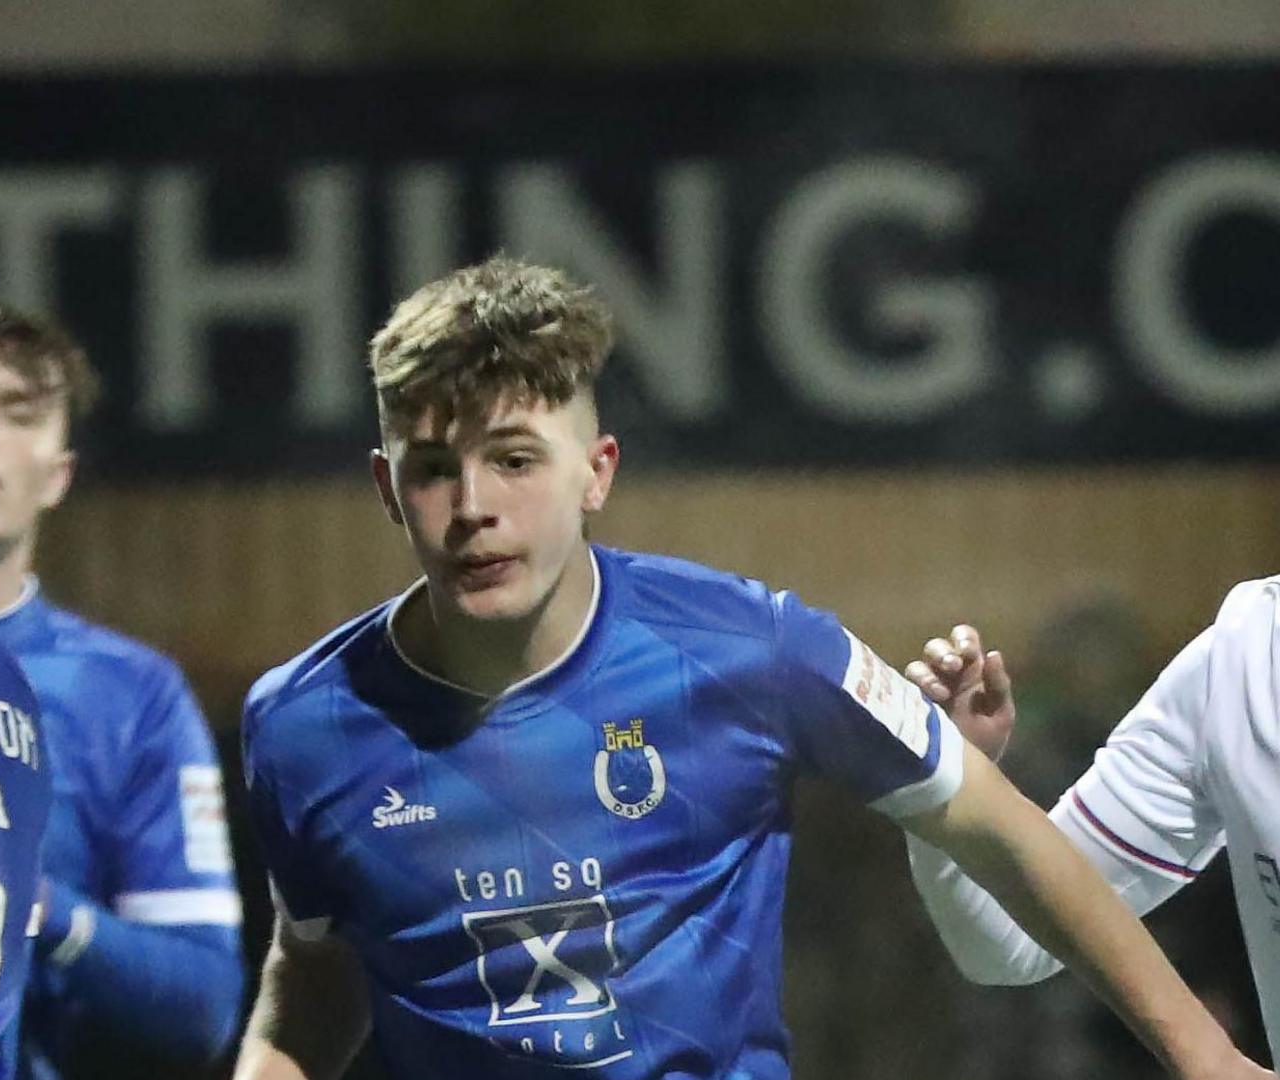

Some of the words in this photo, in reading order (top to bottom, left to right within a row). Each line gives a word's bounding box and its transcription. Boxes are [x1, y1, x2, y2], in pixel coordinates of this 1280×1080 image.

[372, 801, 438, 830] Swifts
[454, 867, 525, 902] ten
[552, 857, 603, 891] sq
[482, 910, 604, 1015] X
[521, 1020, 626, 1054] otel
